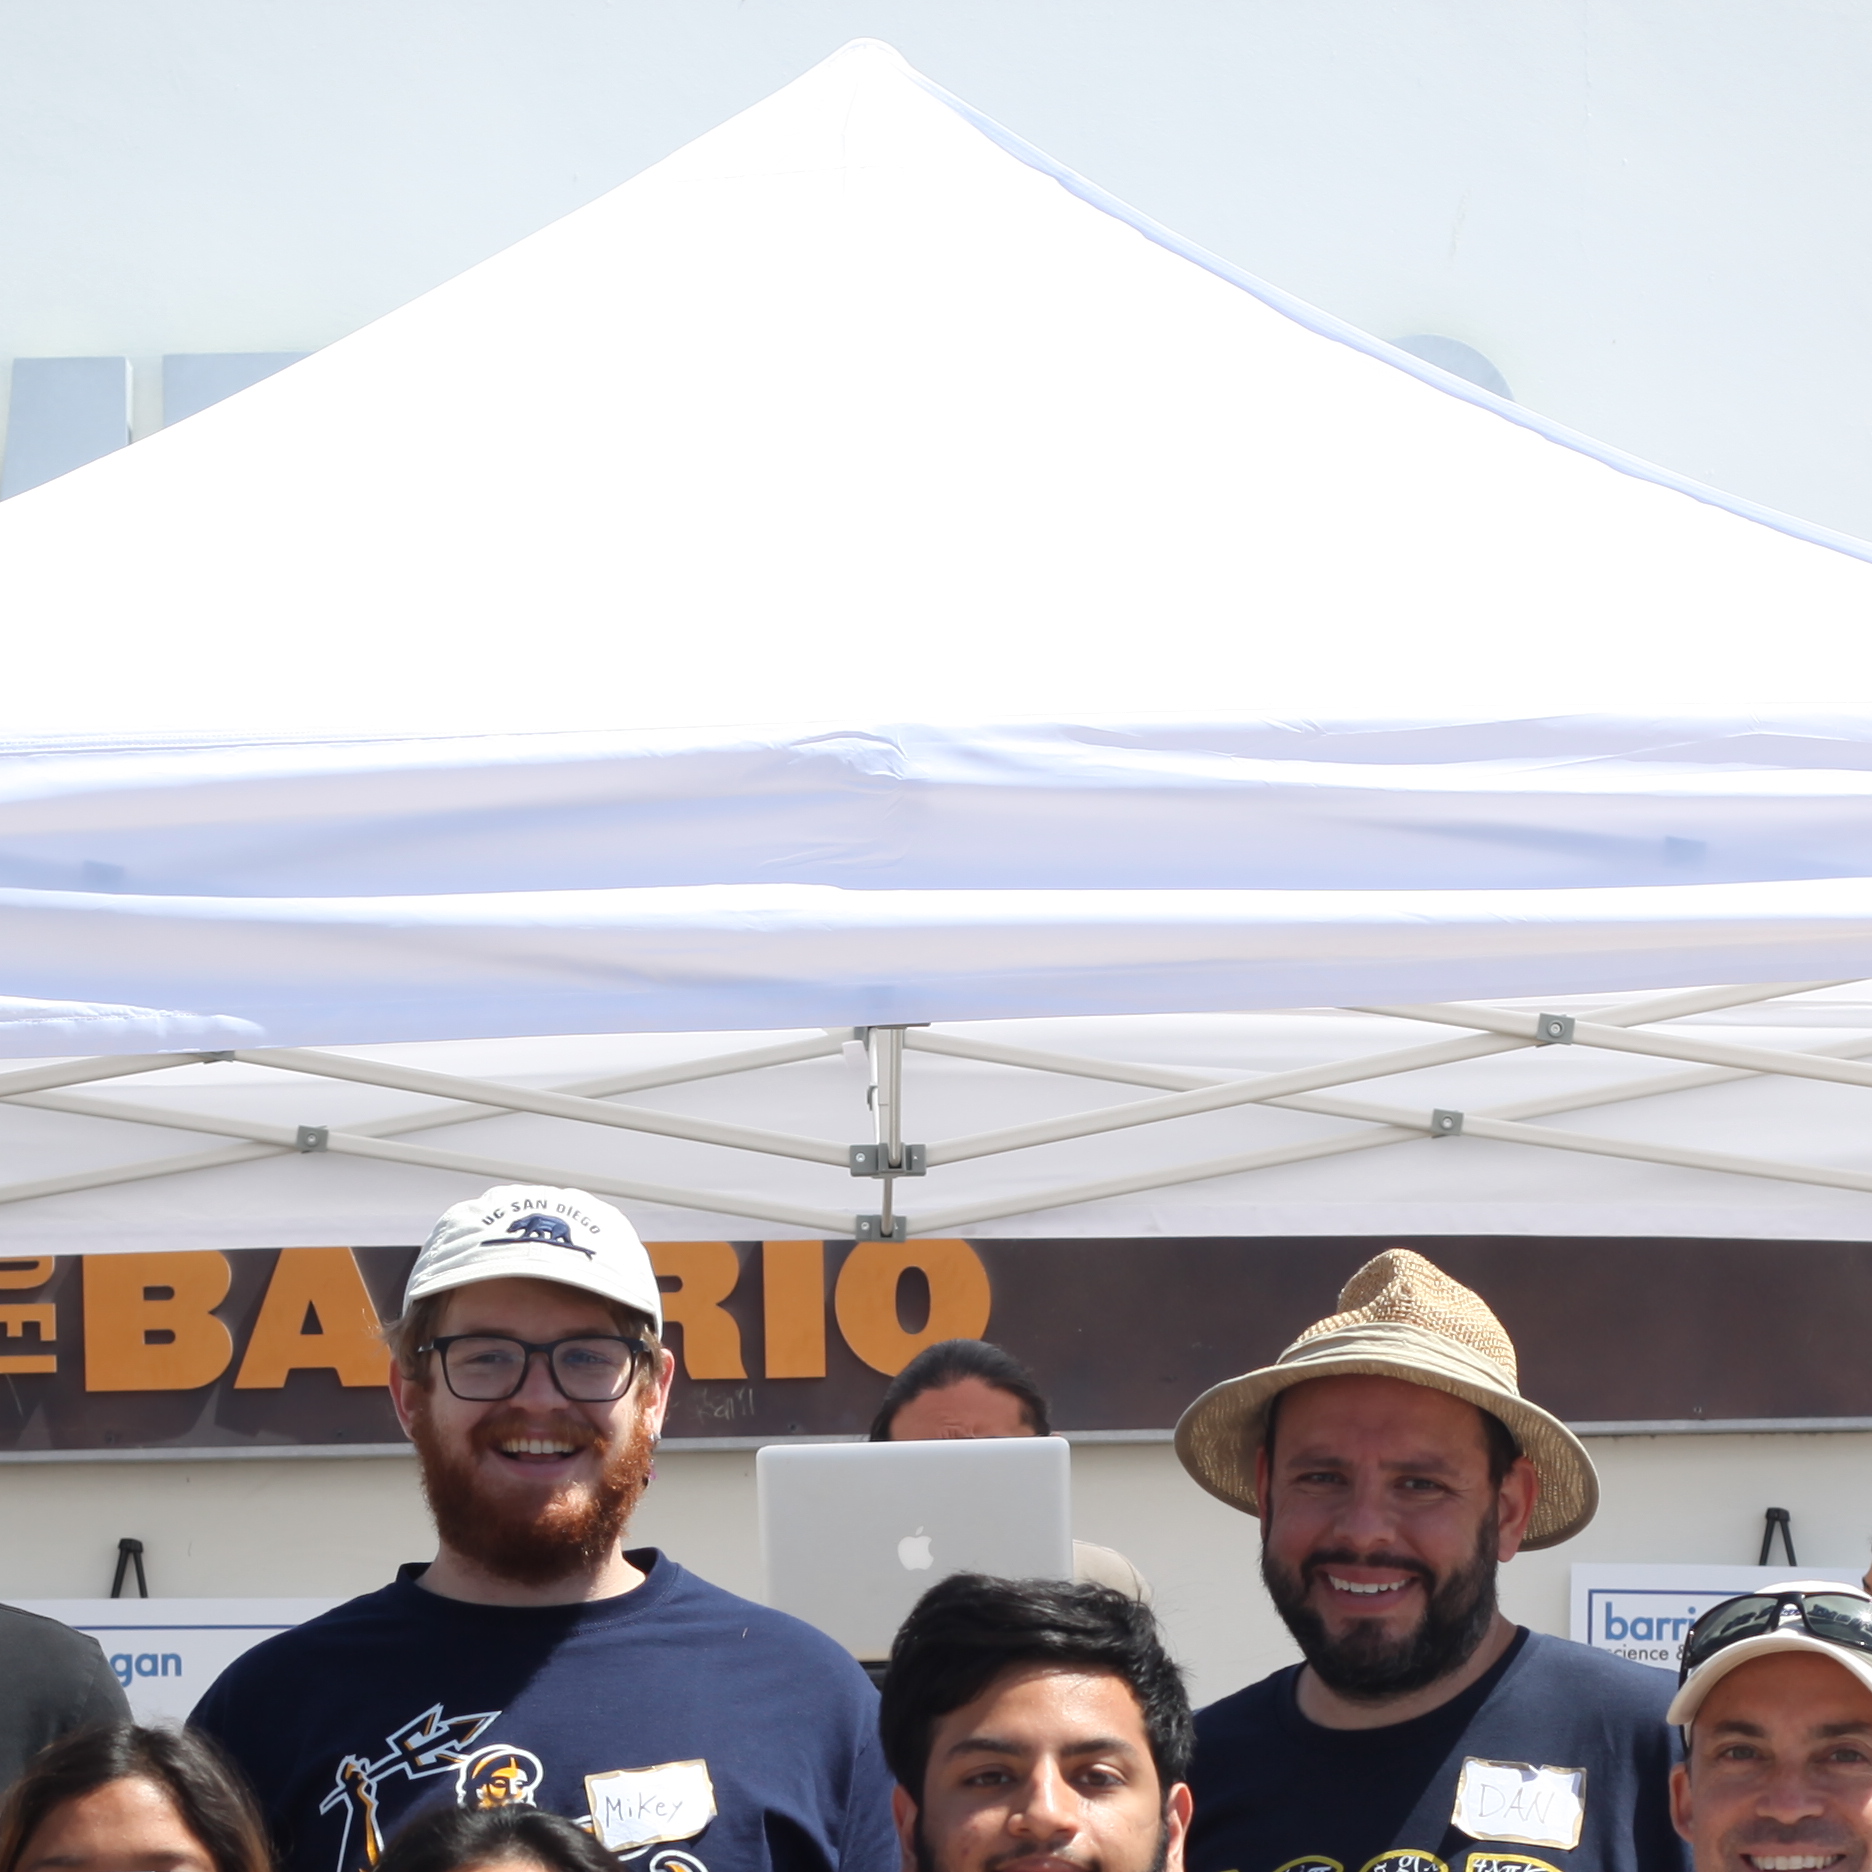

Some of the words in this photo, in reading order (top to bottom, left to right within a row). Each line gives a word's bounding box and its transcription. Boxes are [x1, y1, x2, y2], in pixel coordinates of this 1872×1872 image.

[482, 1208, 505, 1226] UC
[511, 1199, 548, 1213] SAN
[556, 1203, 601, 1235] DIEGO
[83, 1237, 992, 1392] BARIO
[1478, 1783, 1556, 1824] DAN
